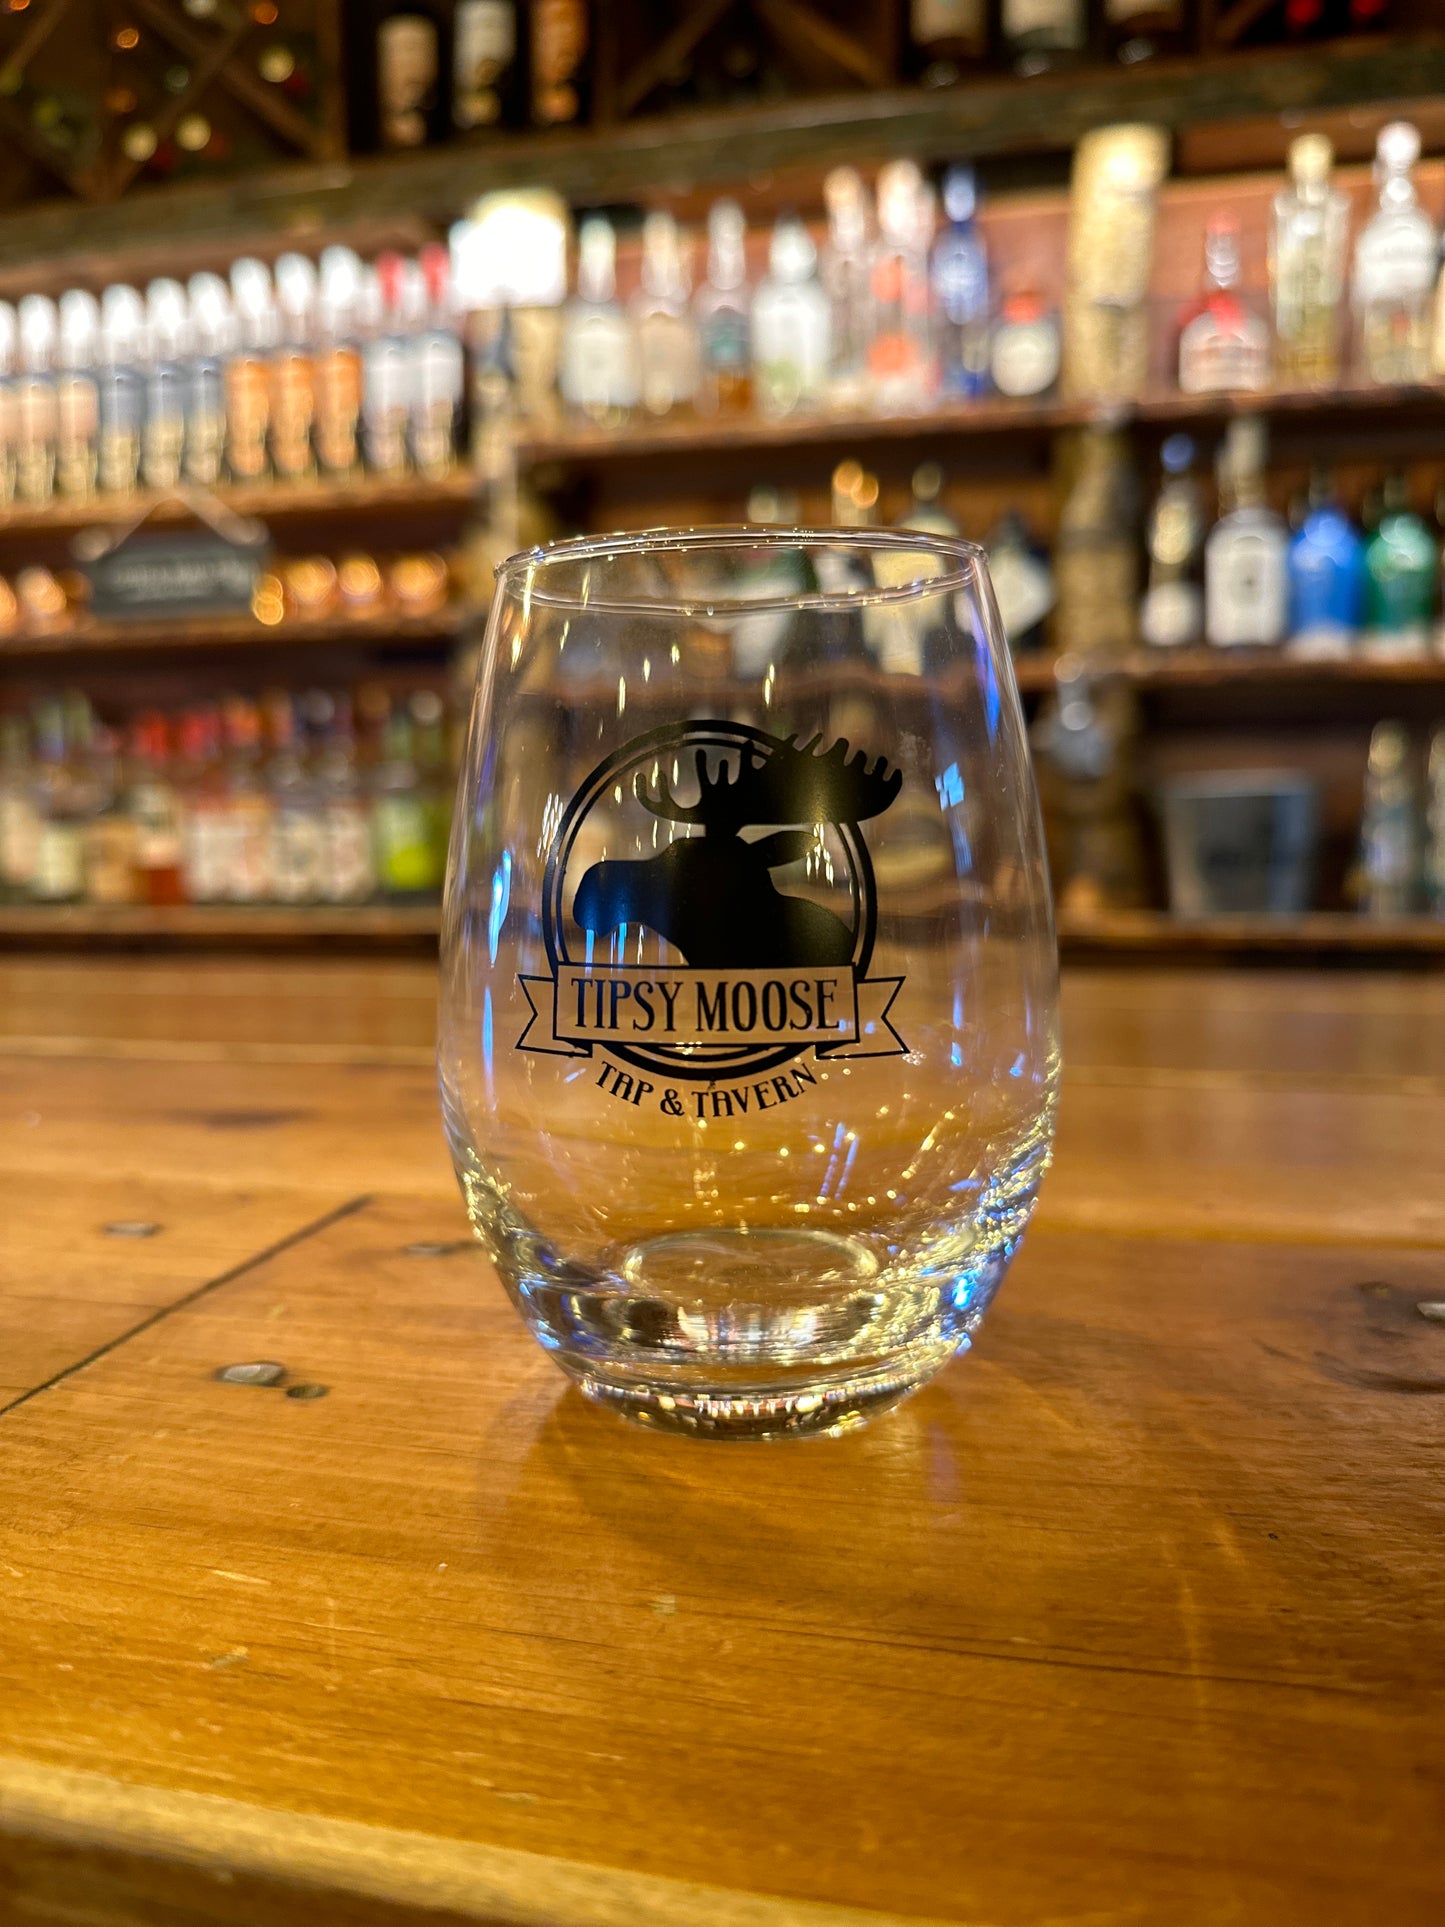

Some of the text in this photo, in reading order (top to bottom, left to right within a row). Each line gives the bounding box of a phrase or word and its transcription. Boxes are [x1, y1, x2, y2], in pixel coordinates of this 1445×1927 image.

[570, 977, 840, 1032] TIPSY MOOSE
[595, 1060, 818, 1118] TAP & TAVERN
